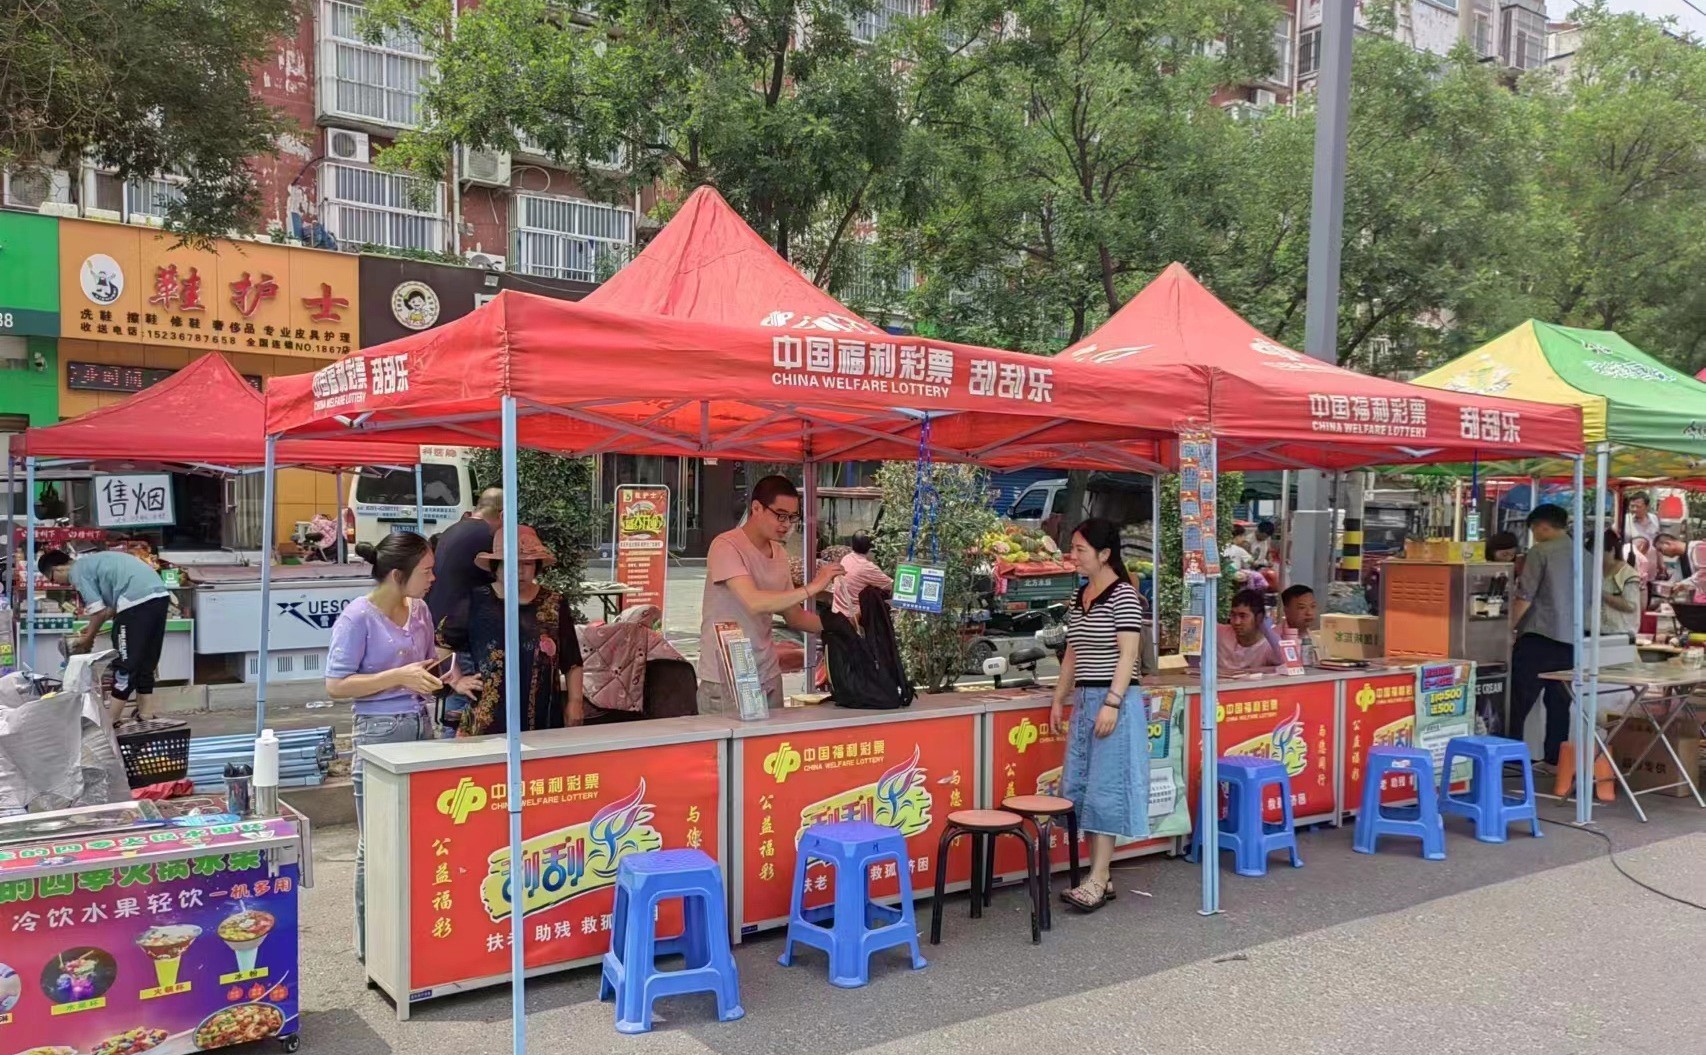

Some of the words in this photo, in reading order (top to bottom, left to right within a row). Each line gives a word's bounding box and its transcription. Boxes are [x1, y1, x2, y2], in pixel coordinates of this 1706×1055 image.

[150, 263, 350, 323] 鞋护士
[80, 308, 113, 322] 洗鞋
[170, 315, 201, 329] 修鞋
[212, 319, 255, 334] 奢侈品
[264, 325, 351, 344] 专业皮具护理
[370, 352, 409, 395] 刮刮乐
[771, 372, 819, 388] CHINA
[821, 376, 888, 394] WELFARE
[891, 382, 950, 399] LOTTERY
[772, 334, 954, 385] 中国福利彩票
[968, 358, 1054, 402] 刮刮乐
[1308, 394, 1427, 425] 中国福利彩票
[1459, 406, 1521, 443] 刮刮乐
[1312, 421, 1342, 432] CHINA
[1344, 423, 1386, 436] WELFARE
[1388, 426, 1427, 438] LOTTERY
[102, 478, 166, 517] 售烟
[803, 740, 884, 762] 中国福利彩票
[825, 760, 854, 769] WELFARE
[856, 756, 884, 765] LOTTERY
[491, 773, 599, 799] 中福利彩票
[562, 792, 599, 802] LOTTERY
[759, 794, 774, 881] 公益福彩
[431, 837, 453, 939] 公益福彩
[870, 862, 897, 880] 救孤
[12, 888, 203, 932] 冷饮水果轻饮
[209, 877, 292, 899] 一机多用
[535, 921, 571, 942] 助残
